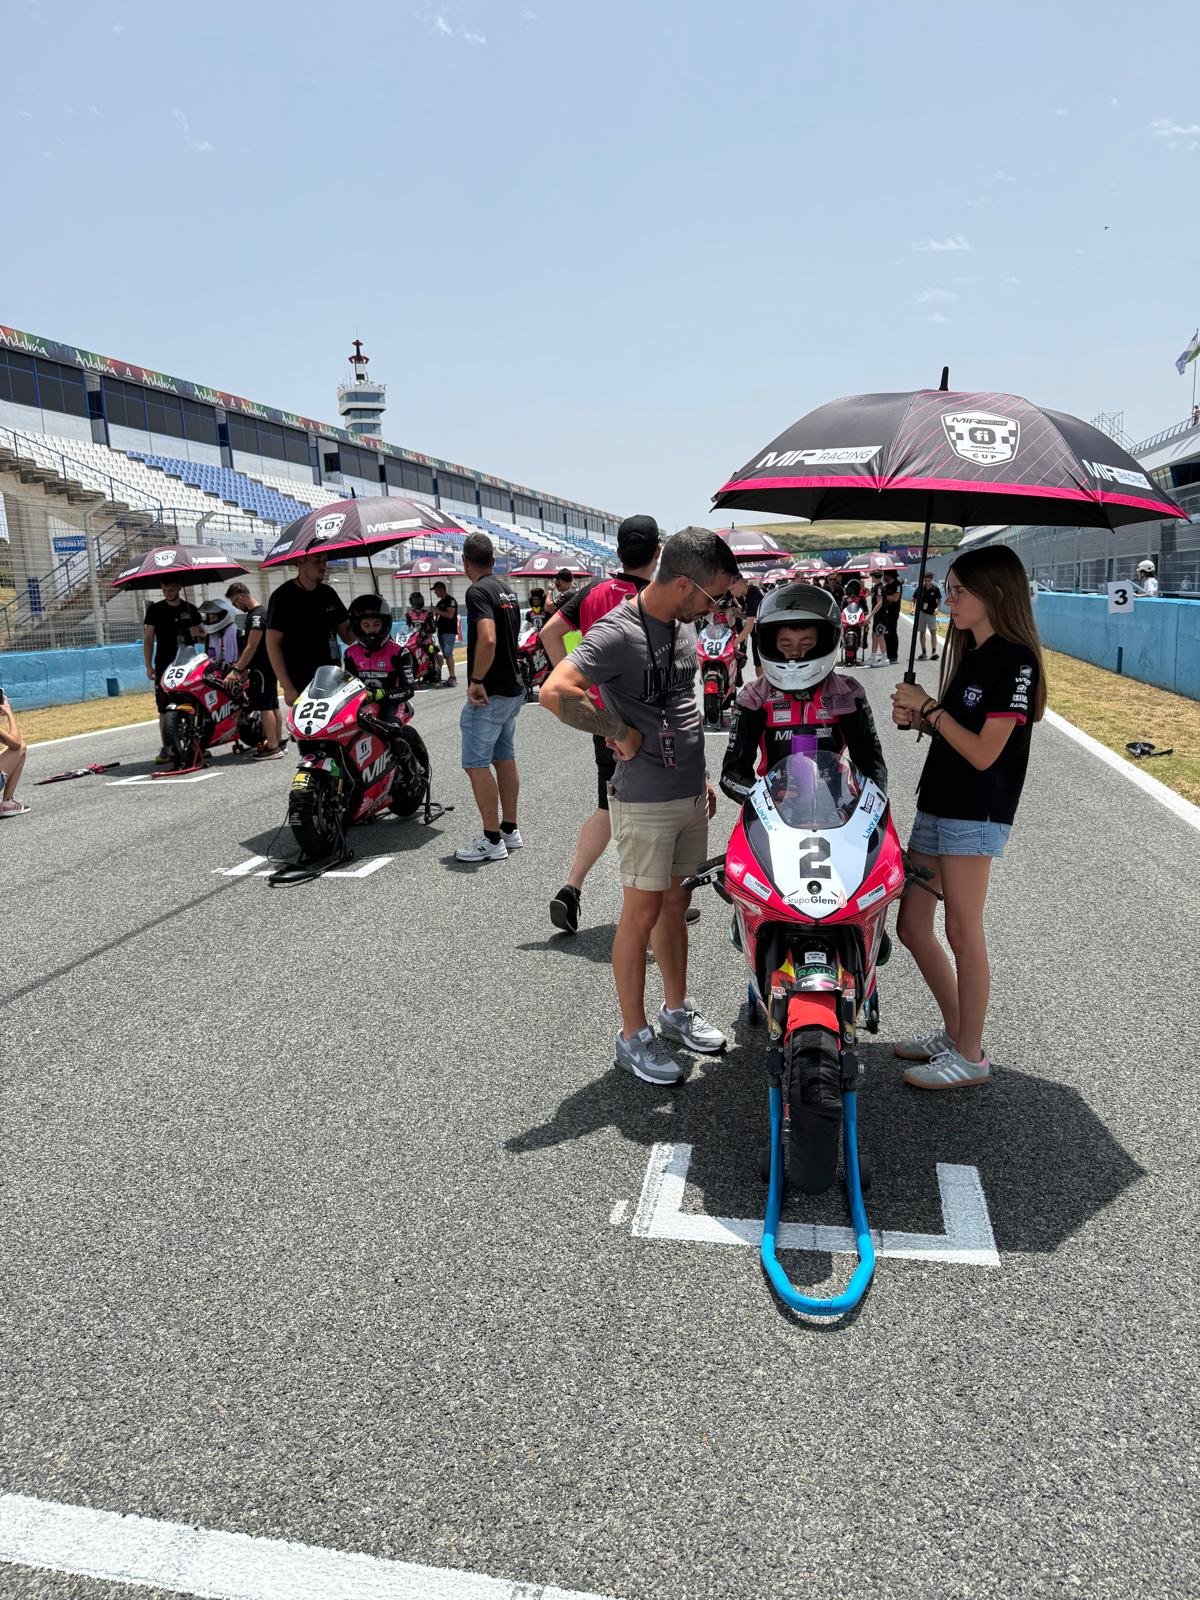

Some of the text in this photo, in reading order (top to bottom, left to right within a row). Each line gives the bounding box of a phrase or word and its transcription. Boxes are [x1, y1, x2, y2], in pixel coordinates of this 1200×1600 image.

[75, 349, 118, 377] Andalucía
[142, 369, 179, 394] Andalucía
[755, 450, 872, 468] MIR RACING
[1081, 459, 1115, 482] MIR
[1114, 589, 1128, 605] 3
[707, 641, 722, 650] 20
[167, 668, 185, 679] 26
[299, 702, 329, 720] 22
[775, 730, 793, 740] MI
[757, 806, 773, 831] LINXAR
[863, 813, 880, 839] LINXAR
[799, 837, 831, 880] 2
